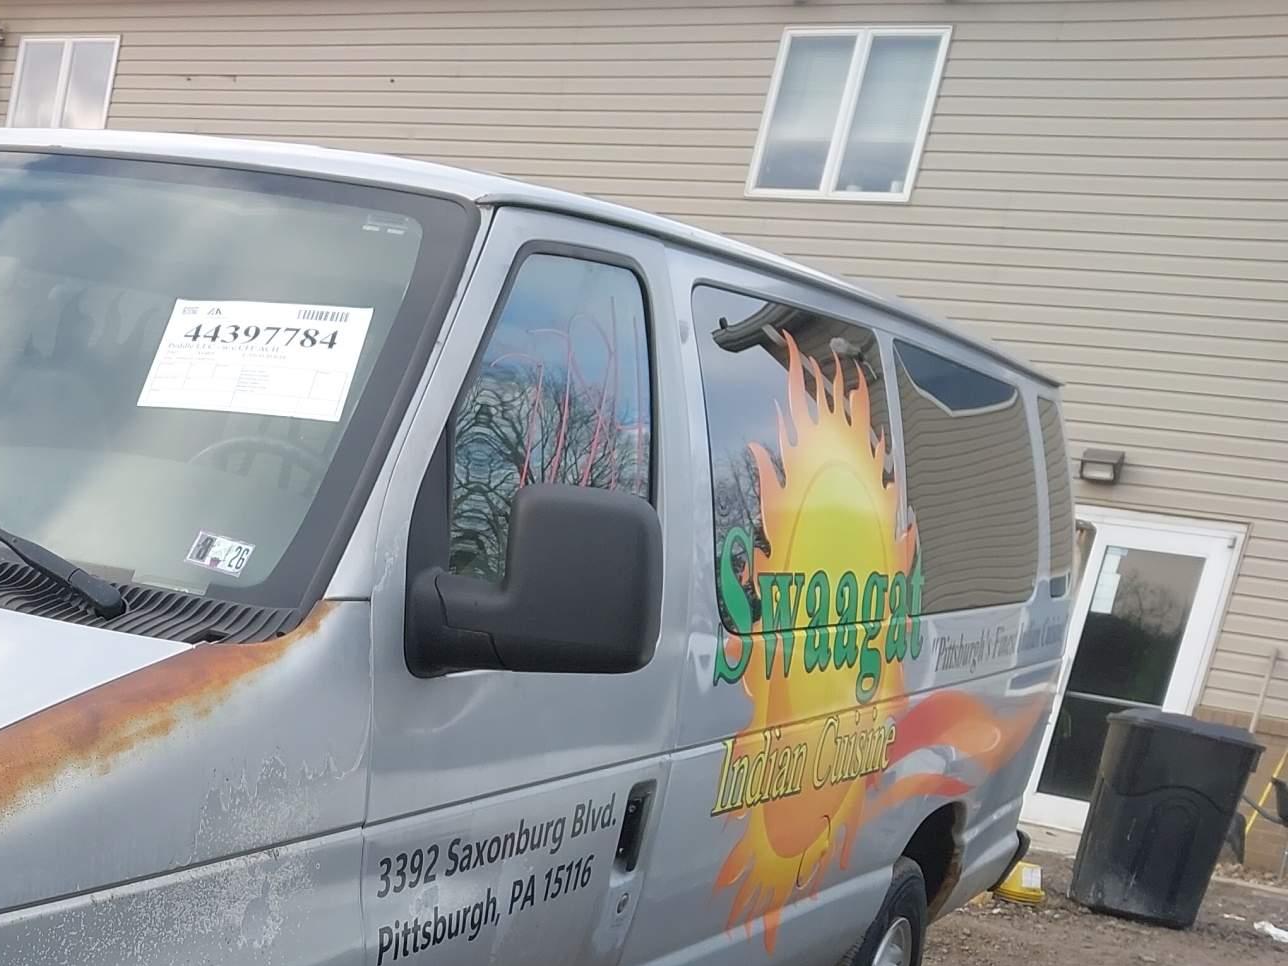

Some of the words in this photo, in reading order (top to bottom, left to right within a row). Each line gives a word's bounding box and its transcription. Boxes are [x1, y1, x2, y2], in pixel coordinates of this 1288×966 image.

[183, 323, 340, 350] 44397784
[227, 545, 250, 570] 26
[713, 525, 925, 704] Swaagat
[711, 726, 808, 817] Indian
[812, 706, 896, 790] Cuisine
[376, 843, 439, 898] 3392
[444, 814, 566, 878] Saxonburg
[570, 792, 617, 839] Blvd.
[376, 888, 500, 966] Pittsburgh,
[508, 873, 535, 916] PA
[543, 855, 595, 901] 15116
